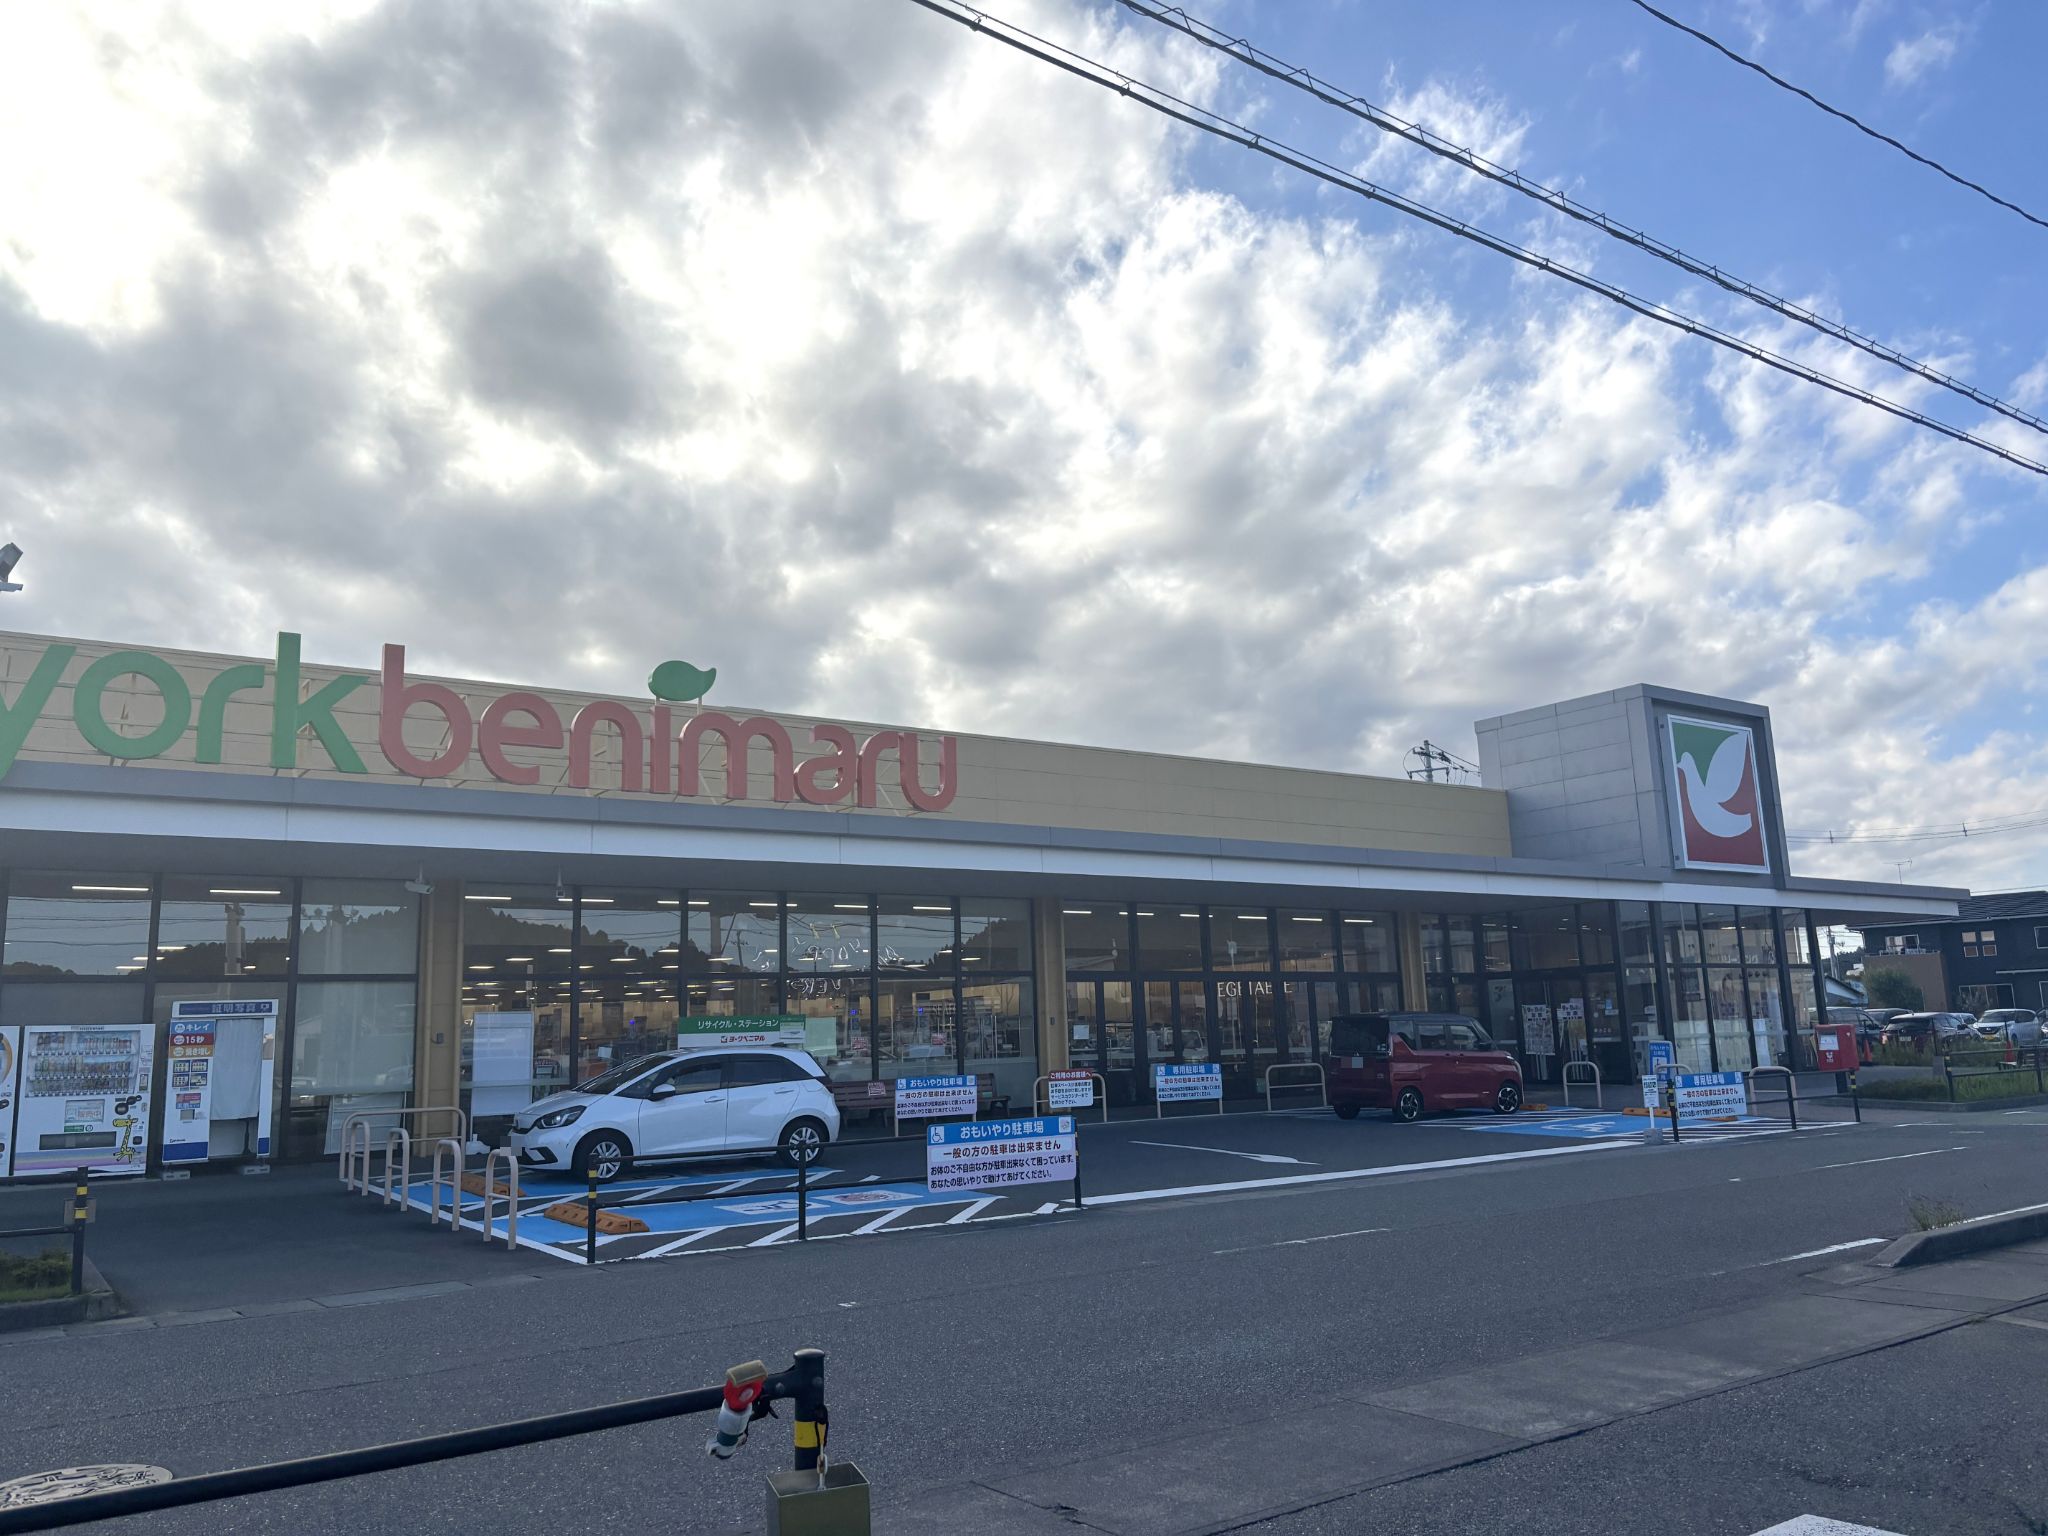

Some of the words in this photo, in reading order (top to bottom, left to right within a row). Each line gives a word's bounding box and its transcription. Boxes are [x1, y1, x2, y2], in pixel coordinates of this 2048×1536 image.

[698, 1019, 779, 1029] リサイクル・ステーション
[910, 1077, 963, 1087] おもいやり駐車場
[960, 1120, 1044, 1139] おもいやり駐車場
[943, 1140, 1061, 1159] 一般の方の駐車は出来ません
[930, 1170, 1052, 1189] あなたの思いやりで助けてあげてください。
